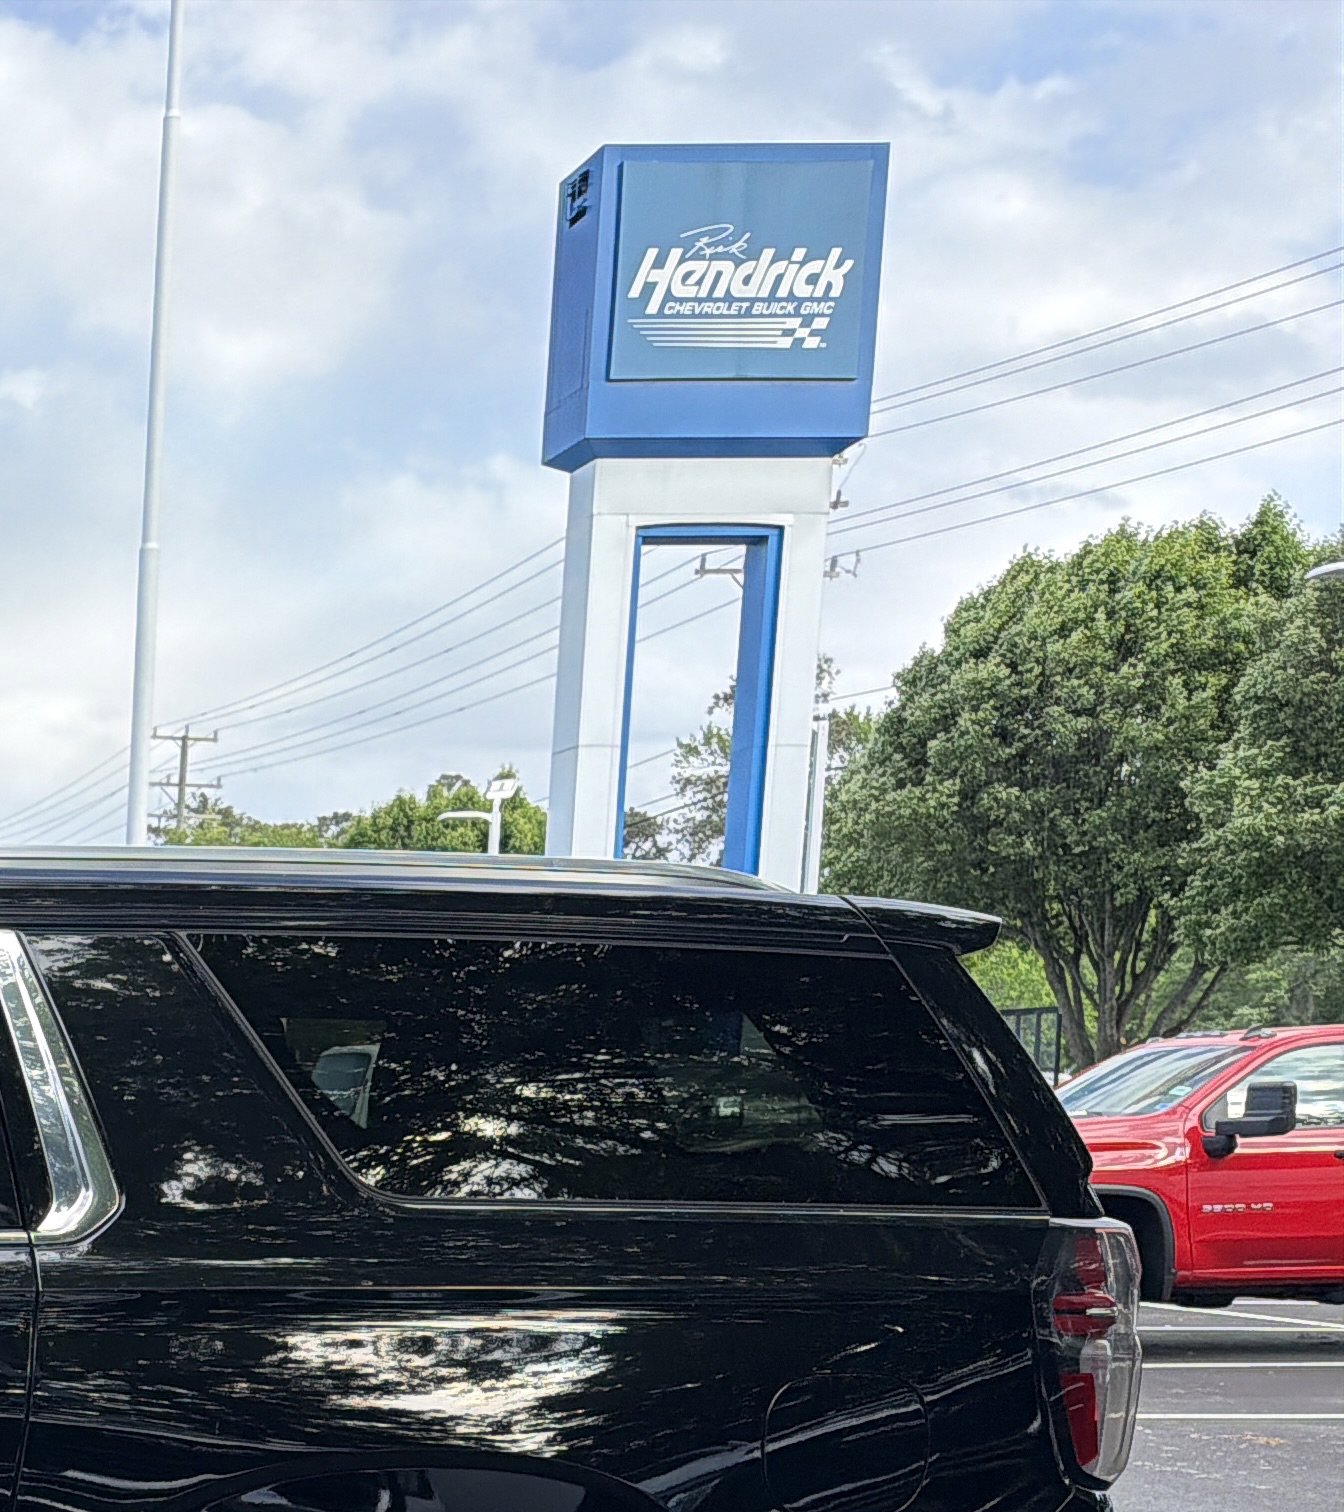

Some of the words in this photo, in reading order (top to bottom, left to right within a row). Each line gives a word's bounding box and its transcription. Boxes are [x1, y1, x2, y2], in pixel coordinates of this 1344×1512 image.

[627, 247, 855, 315] Hendrick
[664, 301, 748, 315] CHEVROLET
[751, 301, 797, 315] BUICK
[799, 301, 835, 315] GMC
